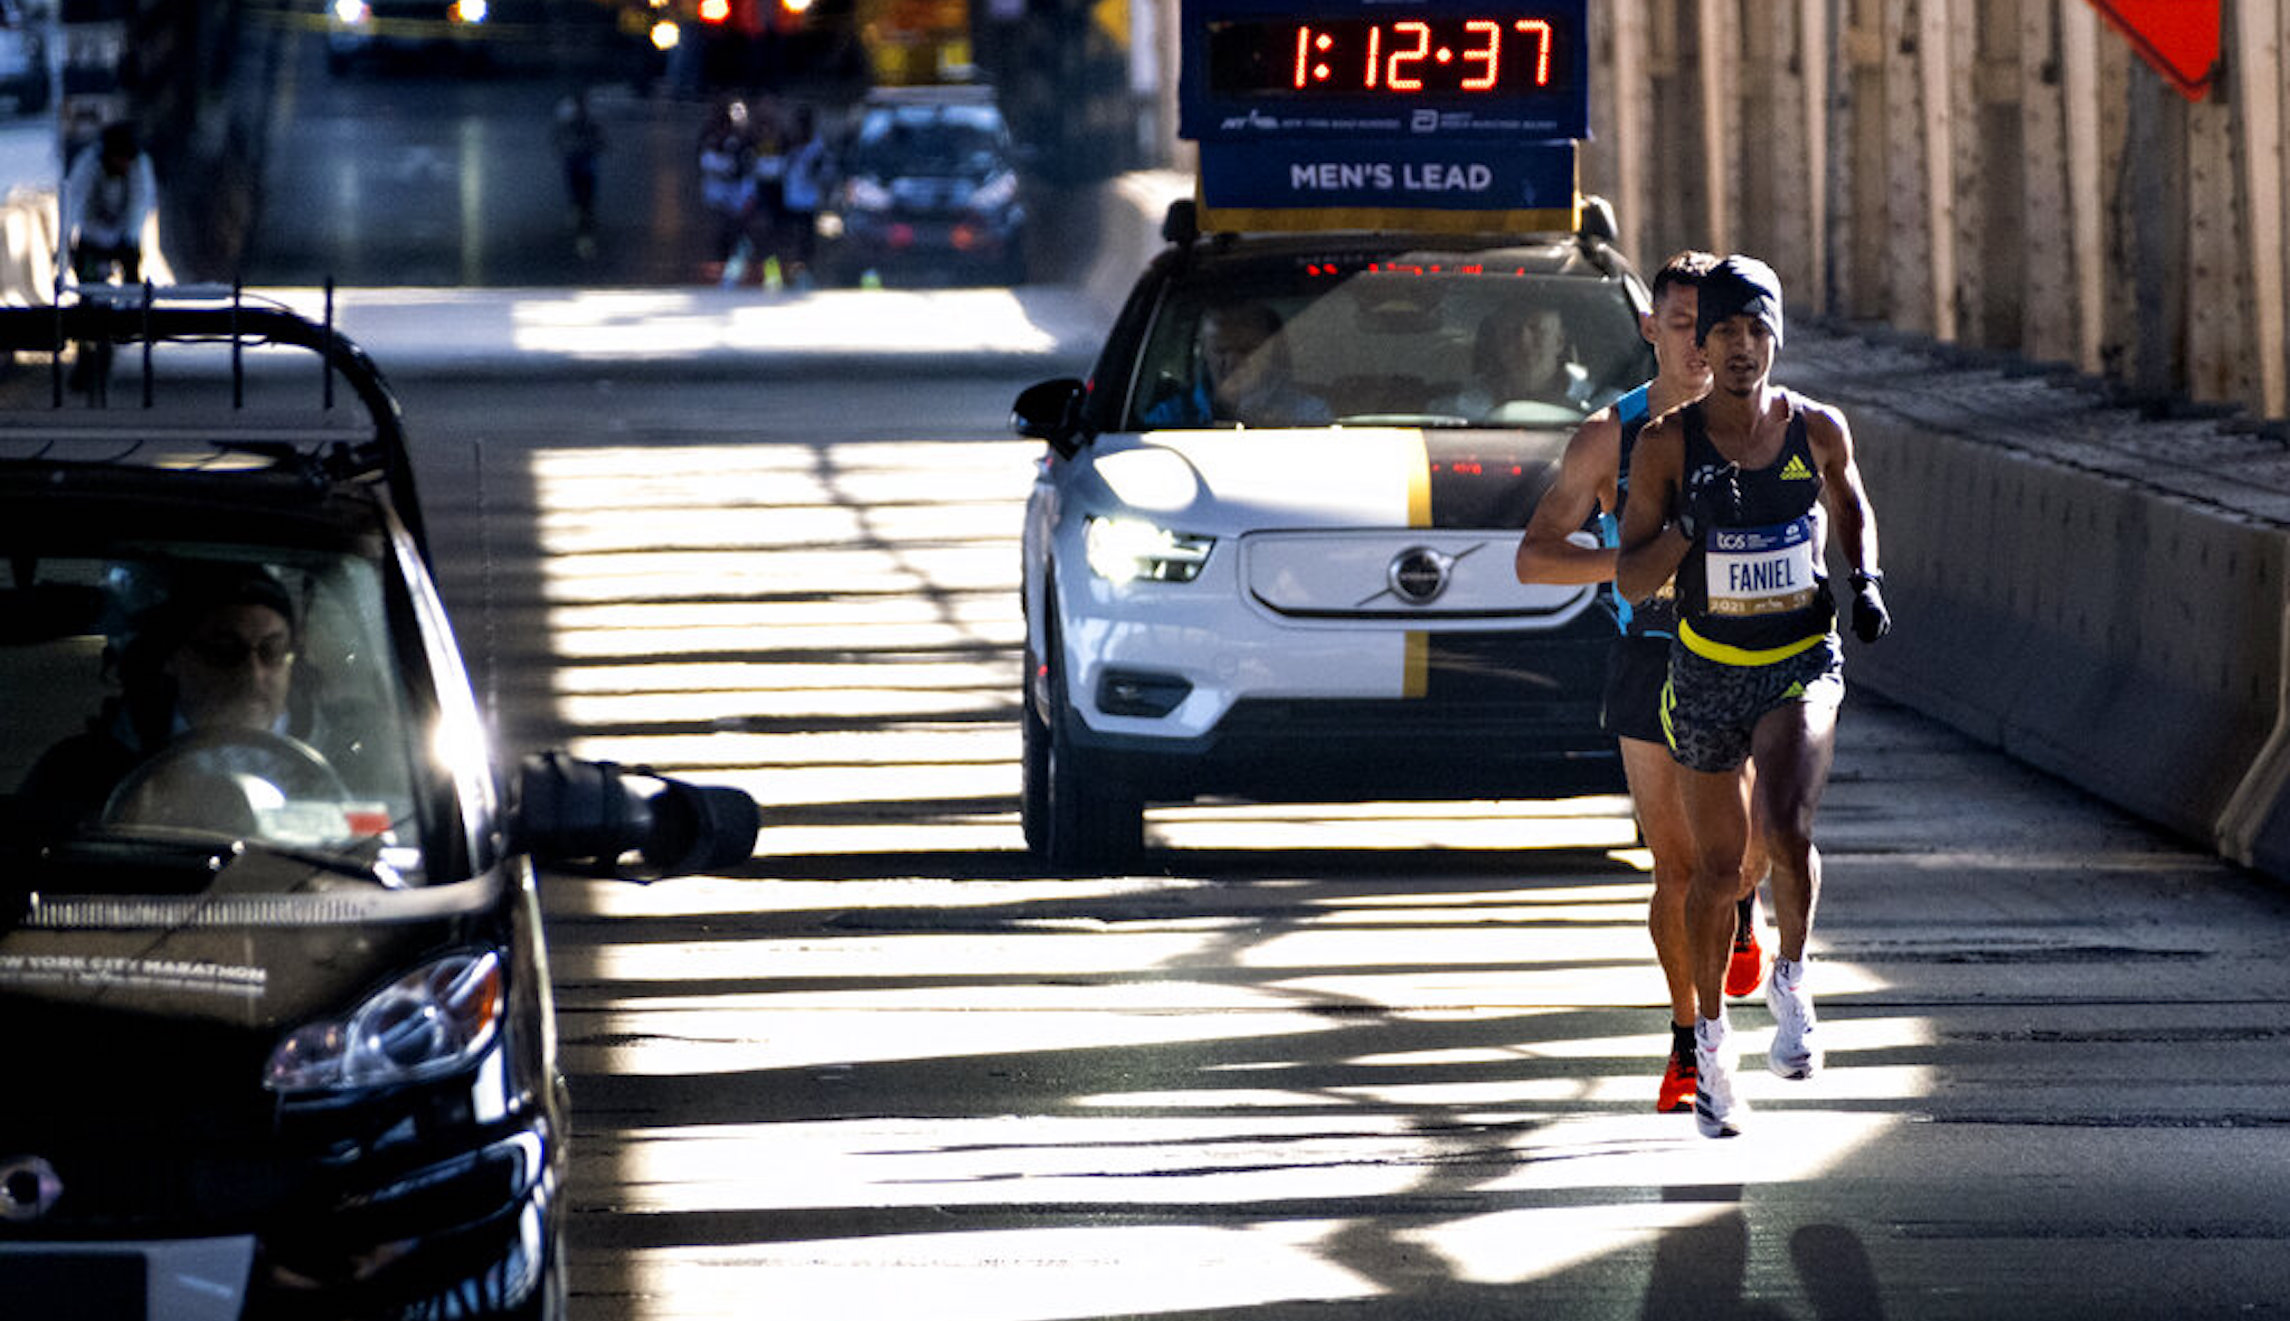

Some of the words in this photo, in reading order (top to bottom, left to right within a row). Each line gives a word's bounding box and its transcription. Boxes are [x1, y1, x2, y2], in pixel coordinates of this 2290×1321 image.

[1291, 164, 1392, 190] MEN'S
[1403, 164, 1491, 190] LEAD
[1730, 558, 1796, 591] FANIEL
[28, 956, 86, 971] YORK
[89, 957, 137, 972] CITY
[142, 960, 267, 982] MARATHON
